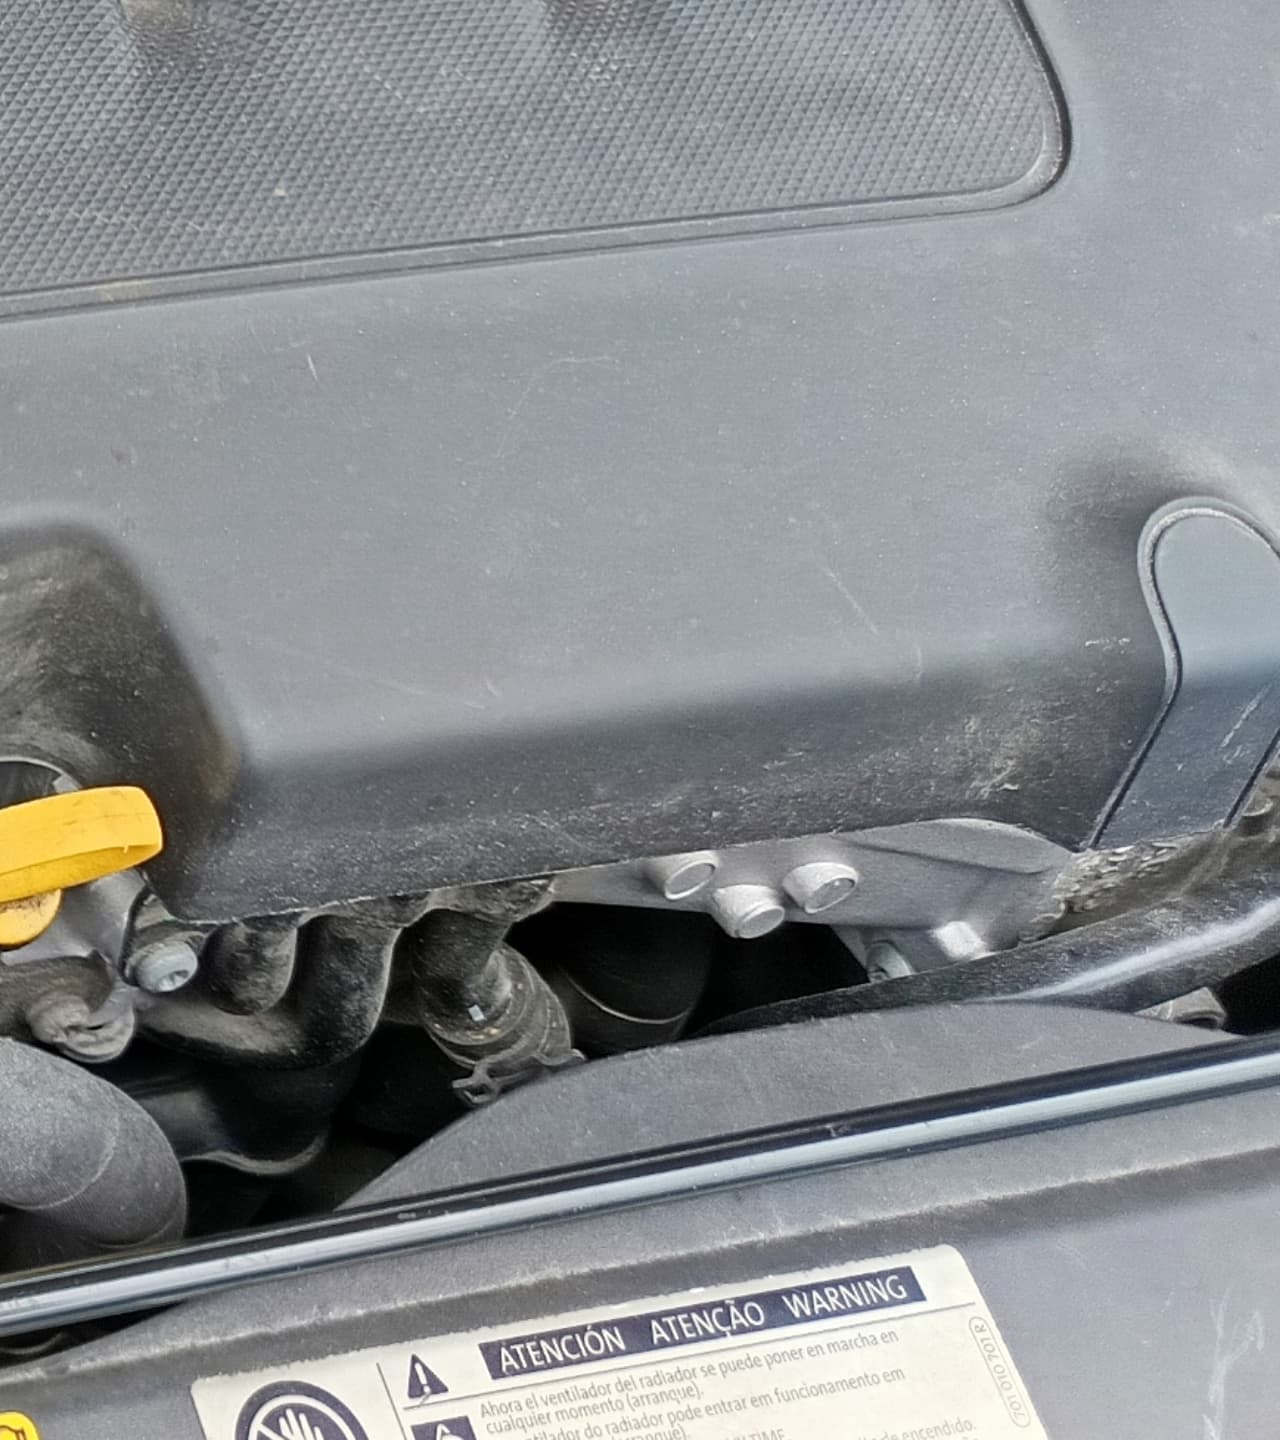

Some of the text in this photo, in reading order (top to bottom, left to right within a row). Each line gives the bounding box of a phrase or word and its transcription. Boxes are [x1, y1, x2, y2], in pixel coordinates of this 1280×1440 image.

[500, 1275, 907, 1375] ATENCIÓN ATENÇÃO WARNING
[975, 1323, 987, 1335] R
[481, 1329, 899, 1419] Ahora el ventilador del radiador se puede poner en marcha en
[486, 1382, 704, 1437] cualquier momento (arranque).
[583, 1422, 603, 1440] do
[605, 1410, 663, 1436] radiador
[667, 1403, 703, 1429] pode
[704, 1397, 747, 1417] entrar
[750, 1392, 775, 1409] em
[774, 1372, 881, 1404] funcionamento
[882, 1366, 906, 1384] em
